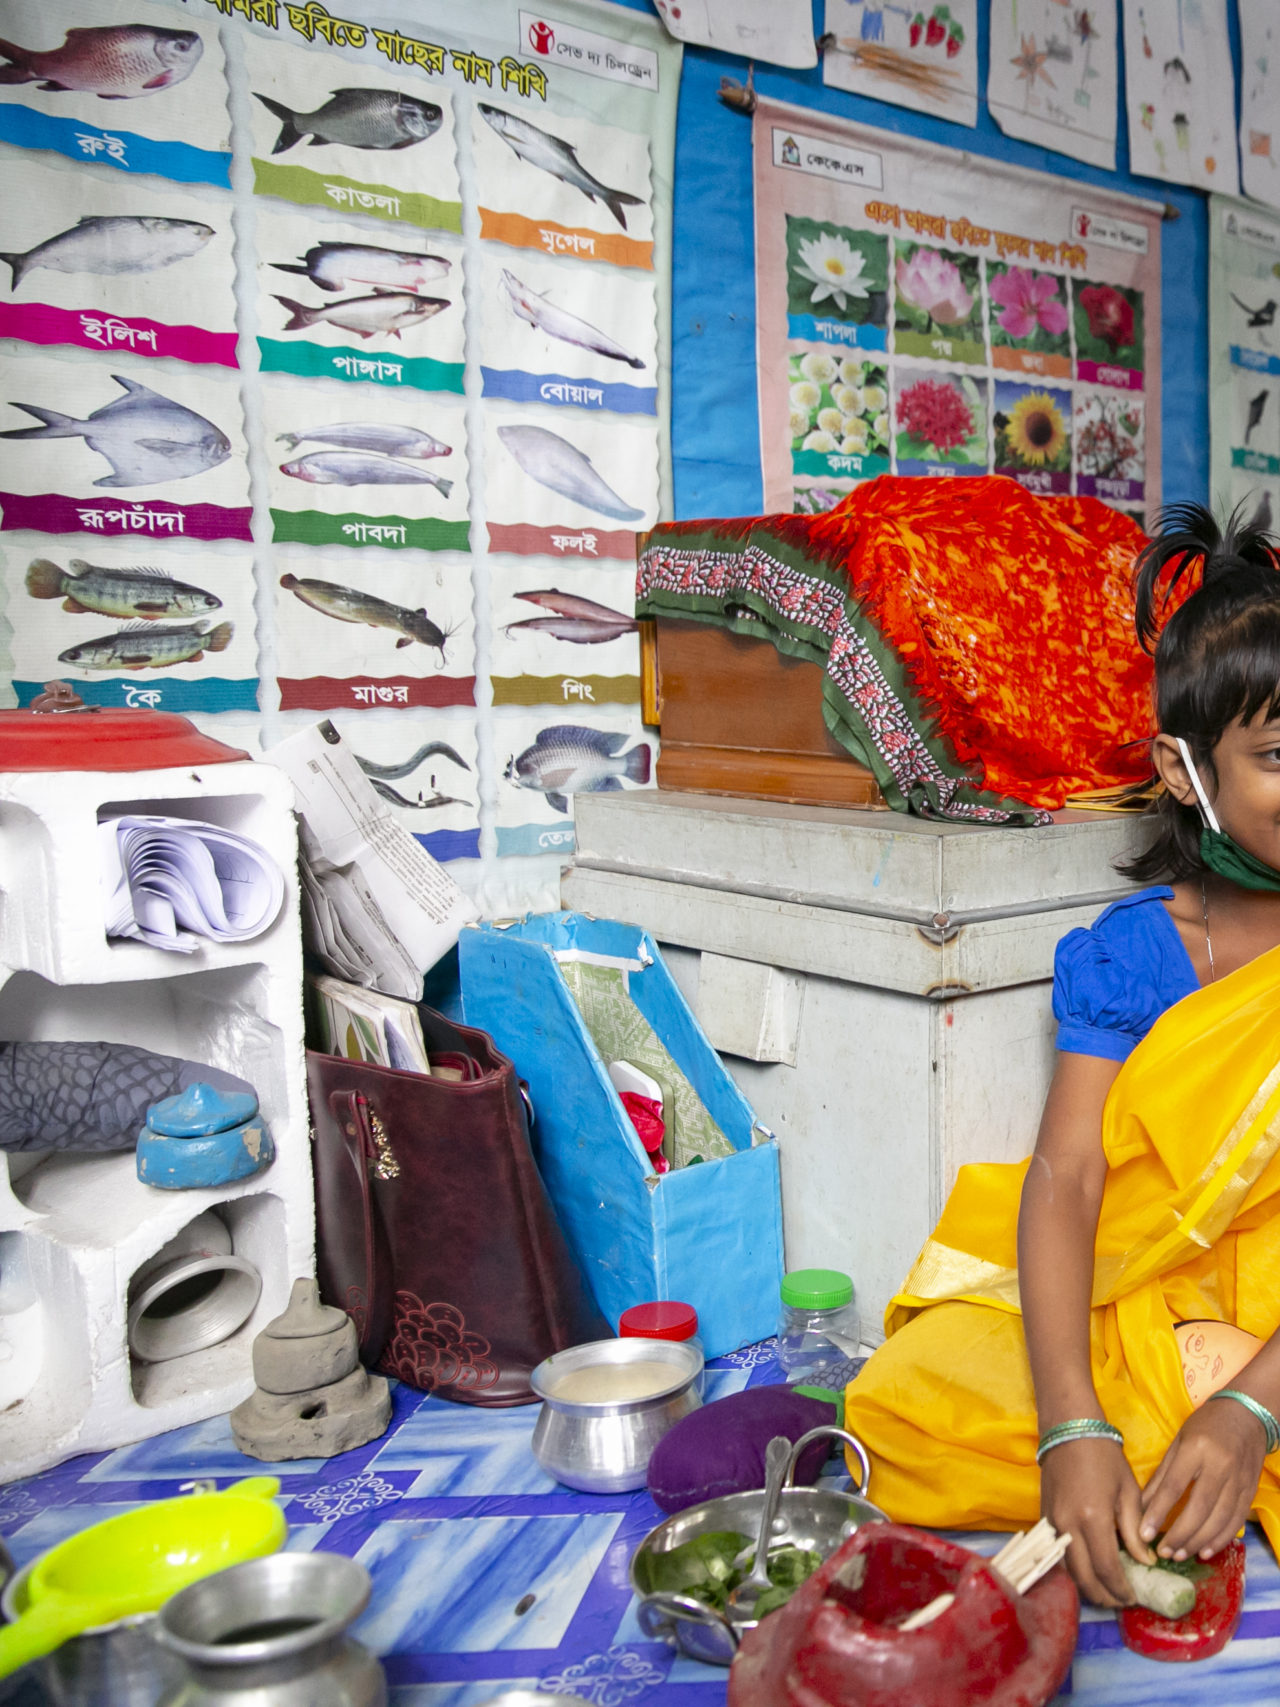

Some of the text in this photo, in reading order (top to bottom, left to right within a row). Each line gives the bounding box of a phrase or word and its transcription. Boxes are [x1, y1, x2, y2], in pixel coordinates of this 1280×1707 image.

[283, 2, 369, 49] ছবিতে
[371, 29, 447, 75] মাছের
[450, 49, 494, 87] নাম
[499, 56, 548, 101] শিখি
[557, 43, 583, 59] সেভ
[74, 132, 130, 168] রুই
[323, 183, 402, 217] কাতলা
[539, 228, 596, 256] মৃগেল
[80, 314, 158, 352] ইলিশ
[814, 321, 857, 344] শাপলা
[332, 355, 404, 382] পাঙ্গাস
[540, 382, 604, 406] বোয়াল
[826, 453, 863, 474] কদম
[76, 504, 186, 533] রূপচাঁদা
[342, 522, 407, 545] পাবদা
[550, 531, 599, 556] ফলই
[121, 683, 163, 708] কৈ
[351, 684, 409, 705] মাগুর
[561, 678, 596, 702] শিং
